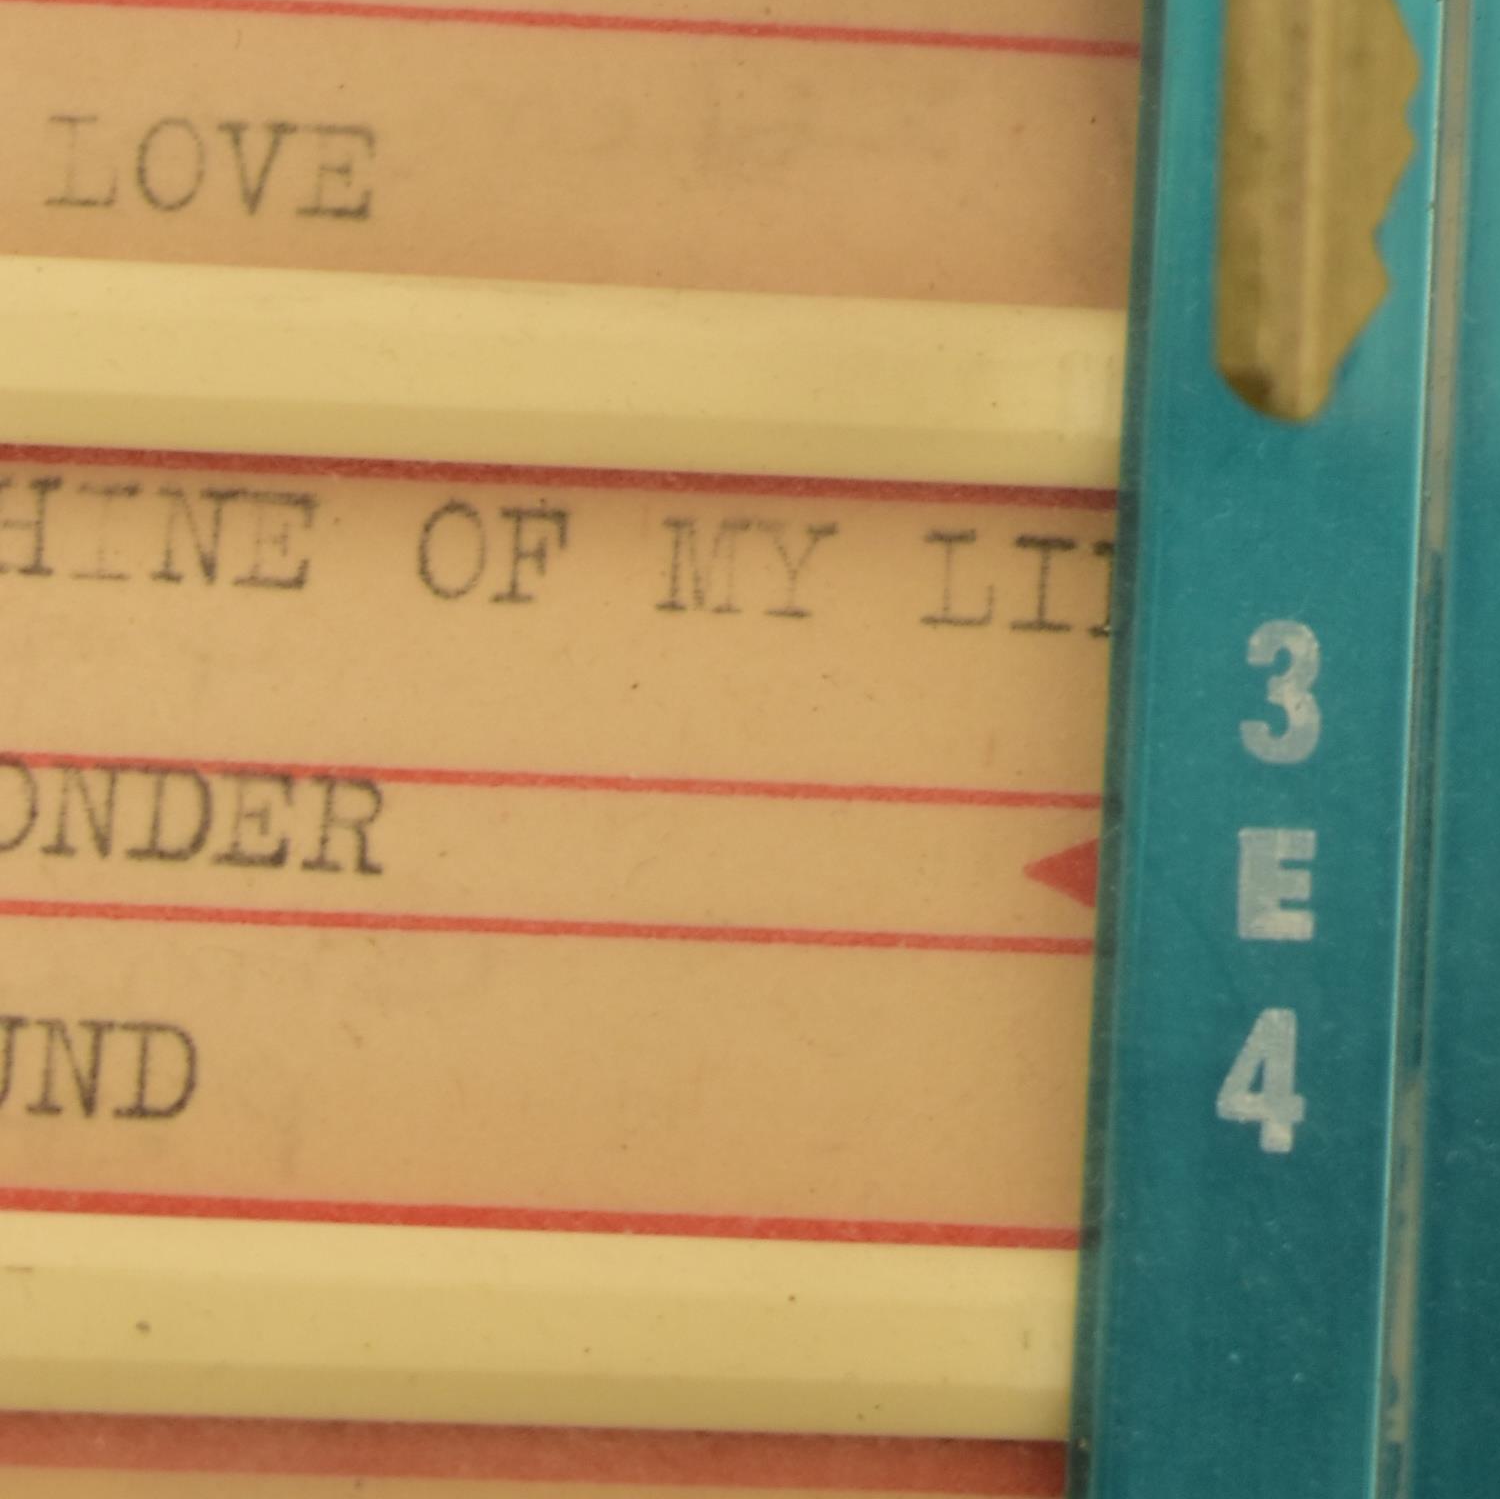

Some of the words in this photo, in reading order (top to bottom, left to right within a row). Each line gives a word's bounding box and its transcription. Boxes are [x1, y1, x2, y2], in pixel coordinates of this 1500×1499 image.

[43, 113, 379, 222] LOVE
[416, 497, 571, 606] OF
[653, 514, 840, 620] MY
[1238, 618, 1323, 766] 3
[1236, 827, 1317, 942] E
[1215, 1006, 1306, 1154] 4
